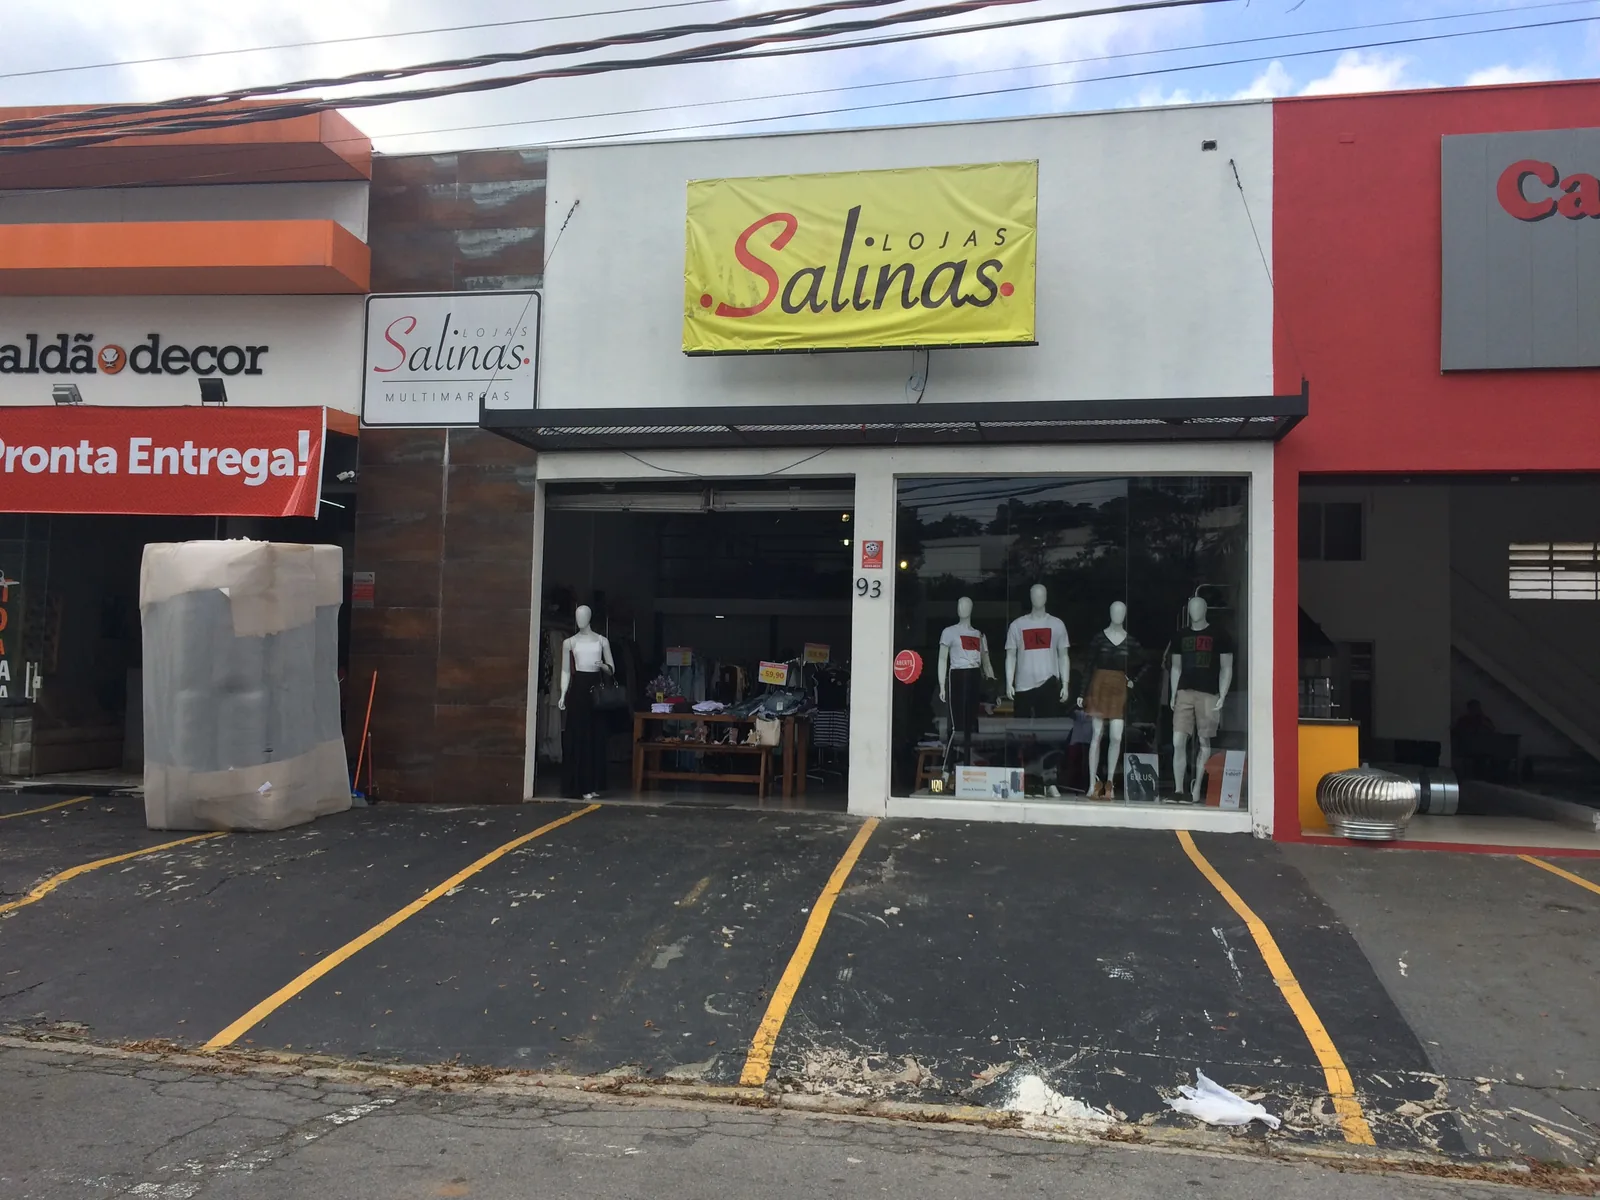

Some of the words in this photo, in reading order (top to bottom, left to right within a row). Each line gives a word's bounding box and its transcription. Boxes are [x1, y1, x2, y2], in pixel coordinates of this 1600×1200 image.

[1496, 159, 1600, 222] Ca
[715, 205, 1004, 318] Salinas
[882, 227, 1007, 251] LOJAS
[129, 334, 269, 375] decor
[373, 312, 526, 373] Salinas
[462, 326, 528, 338] LOJAS
[0, 437, 118, 475] ronta
[128, 430, 310, 486] Entrega!
[856, 577, 882, 598] 93
